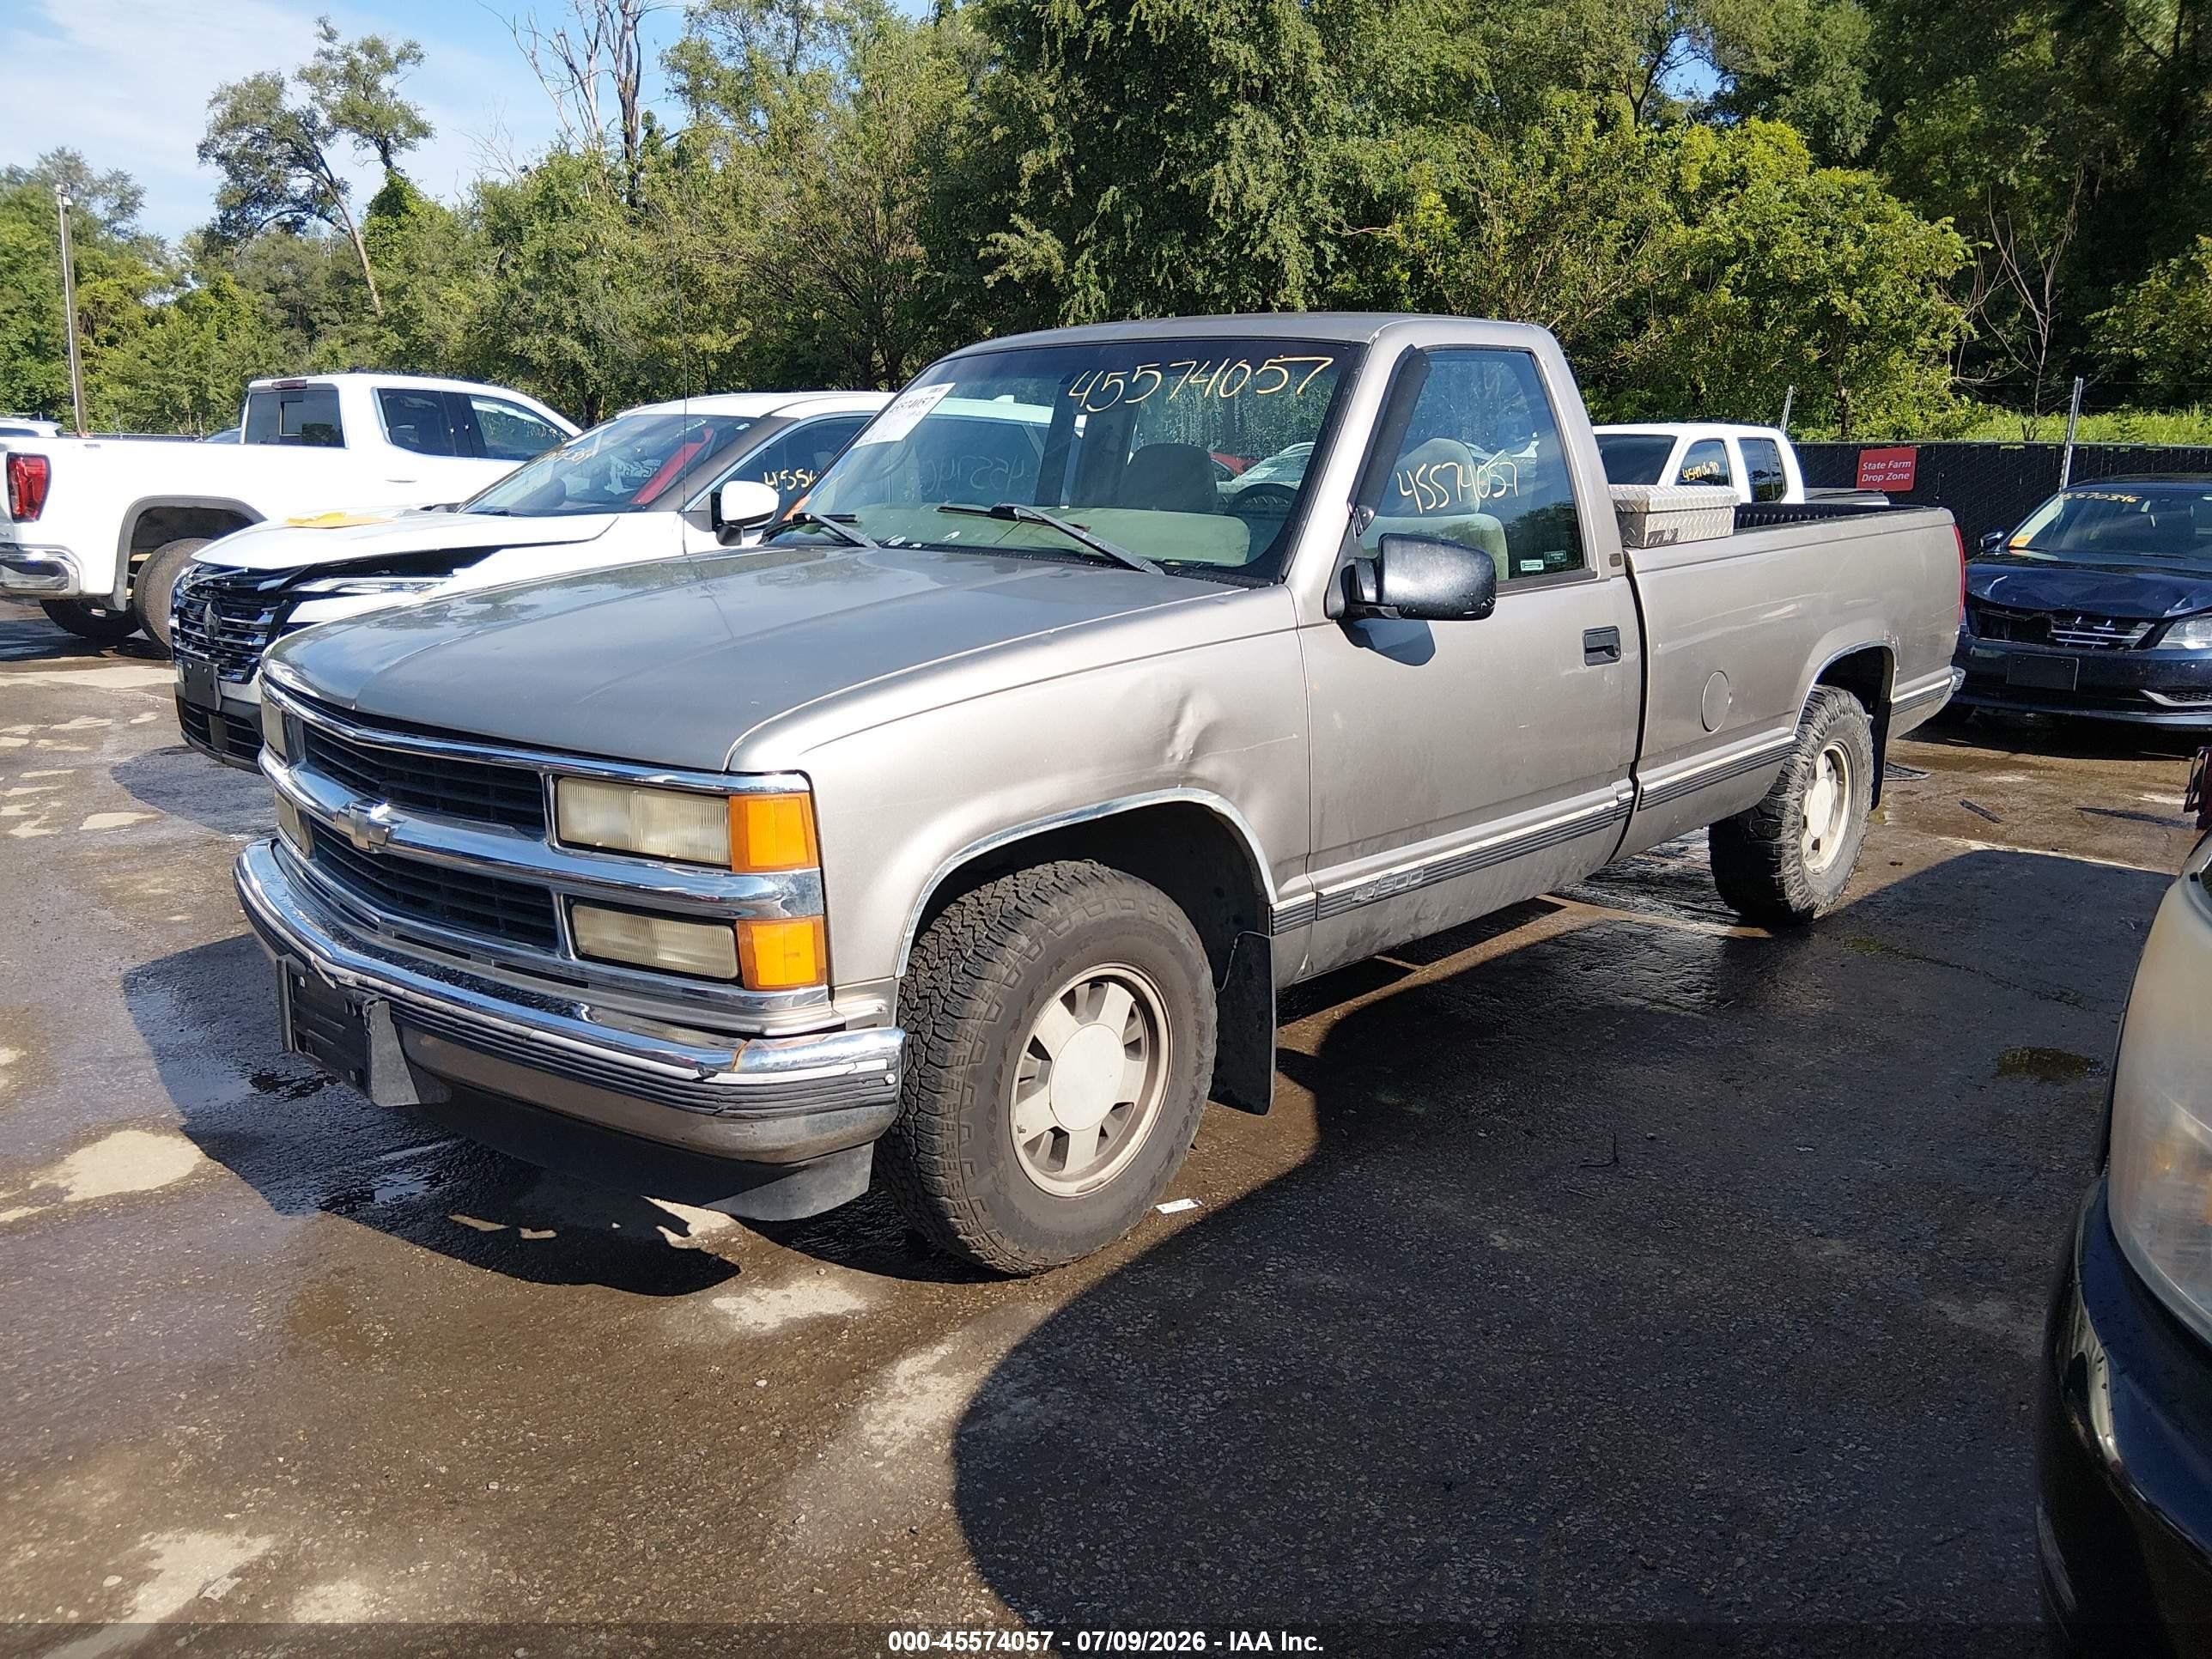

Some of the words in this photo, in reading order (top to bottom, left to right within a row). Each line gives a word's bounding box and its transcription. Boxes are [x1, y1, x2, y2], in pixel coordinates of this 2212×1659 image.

[1068, 356, 1334, 412] 45574057
[1862, 461, 1887, 471] State
[1887, 460, 1911, 469] Farm
[1862, 473, 1884, 483] Drop
[1886, 471, 1911, 481] Zone
[1396, 461, 1519, 514] 45574057
